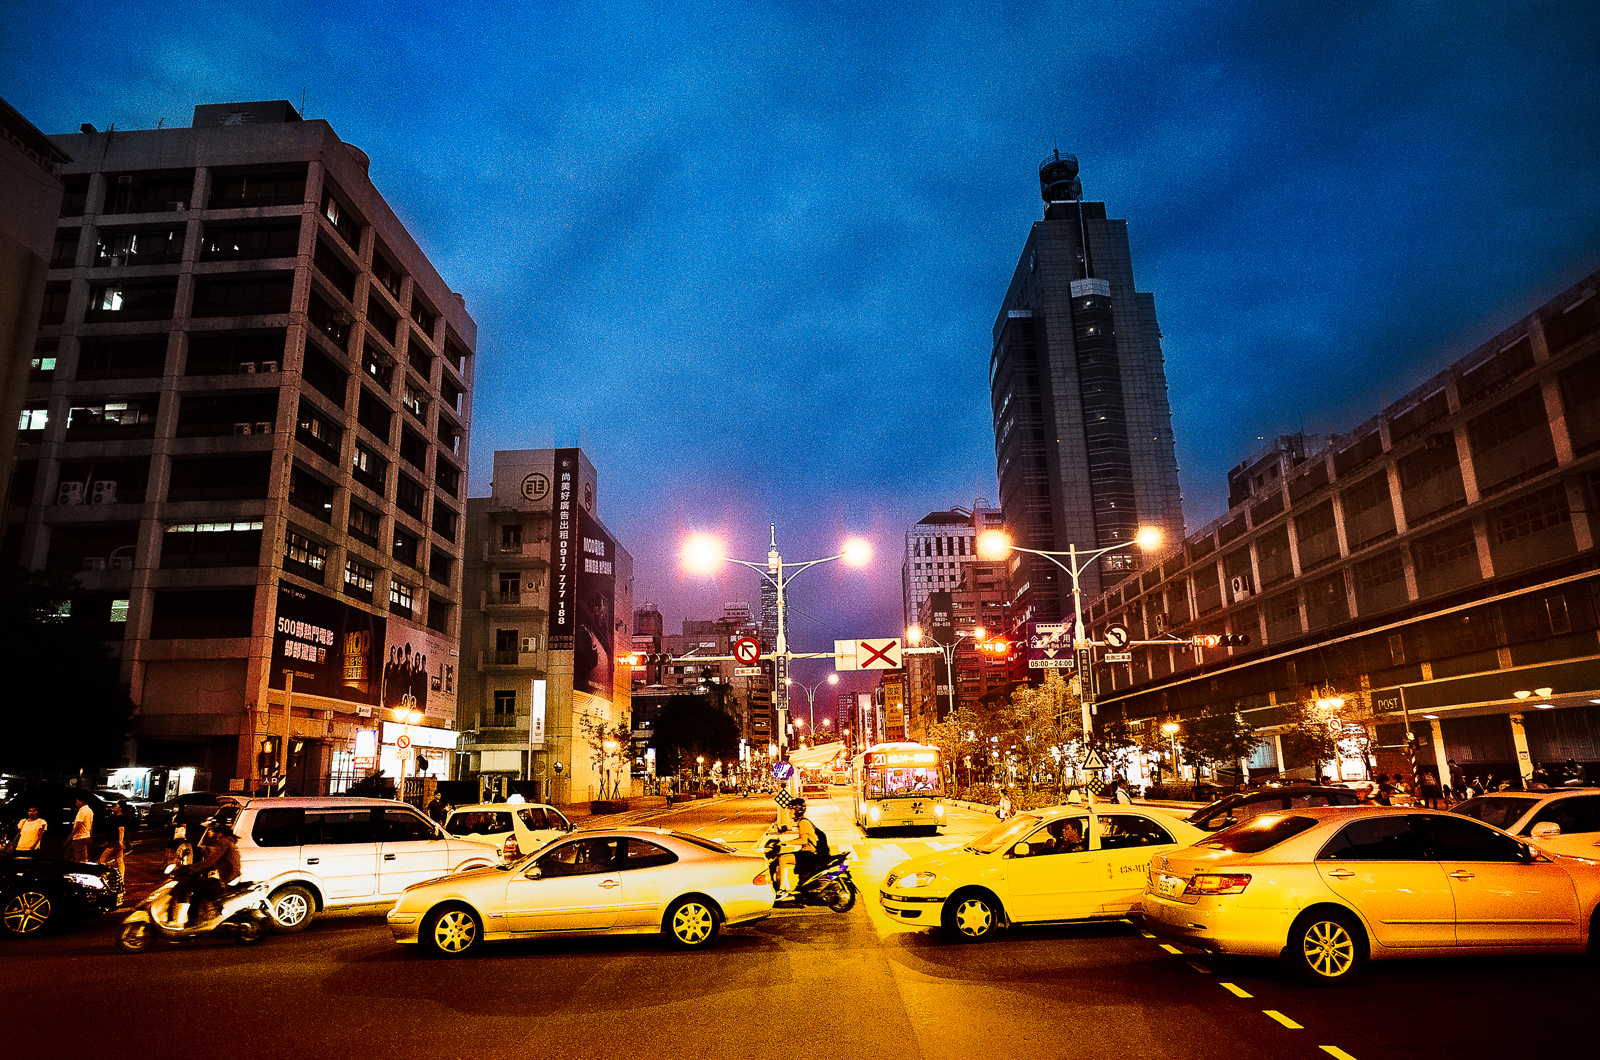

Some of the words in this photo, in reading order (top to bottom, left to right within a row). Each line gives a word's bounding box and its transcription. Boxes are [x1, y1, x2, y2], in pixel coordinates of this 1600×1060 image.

[559, 575, 567, 597] 777
[343, 629, 370, 655] MOD
[1378, 698, 1398, 710] POST
[874, 753, 886, 766] 20
